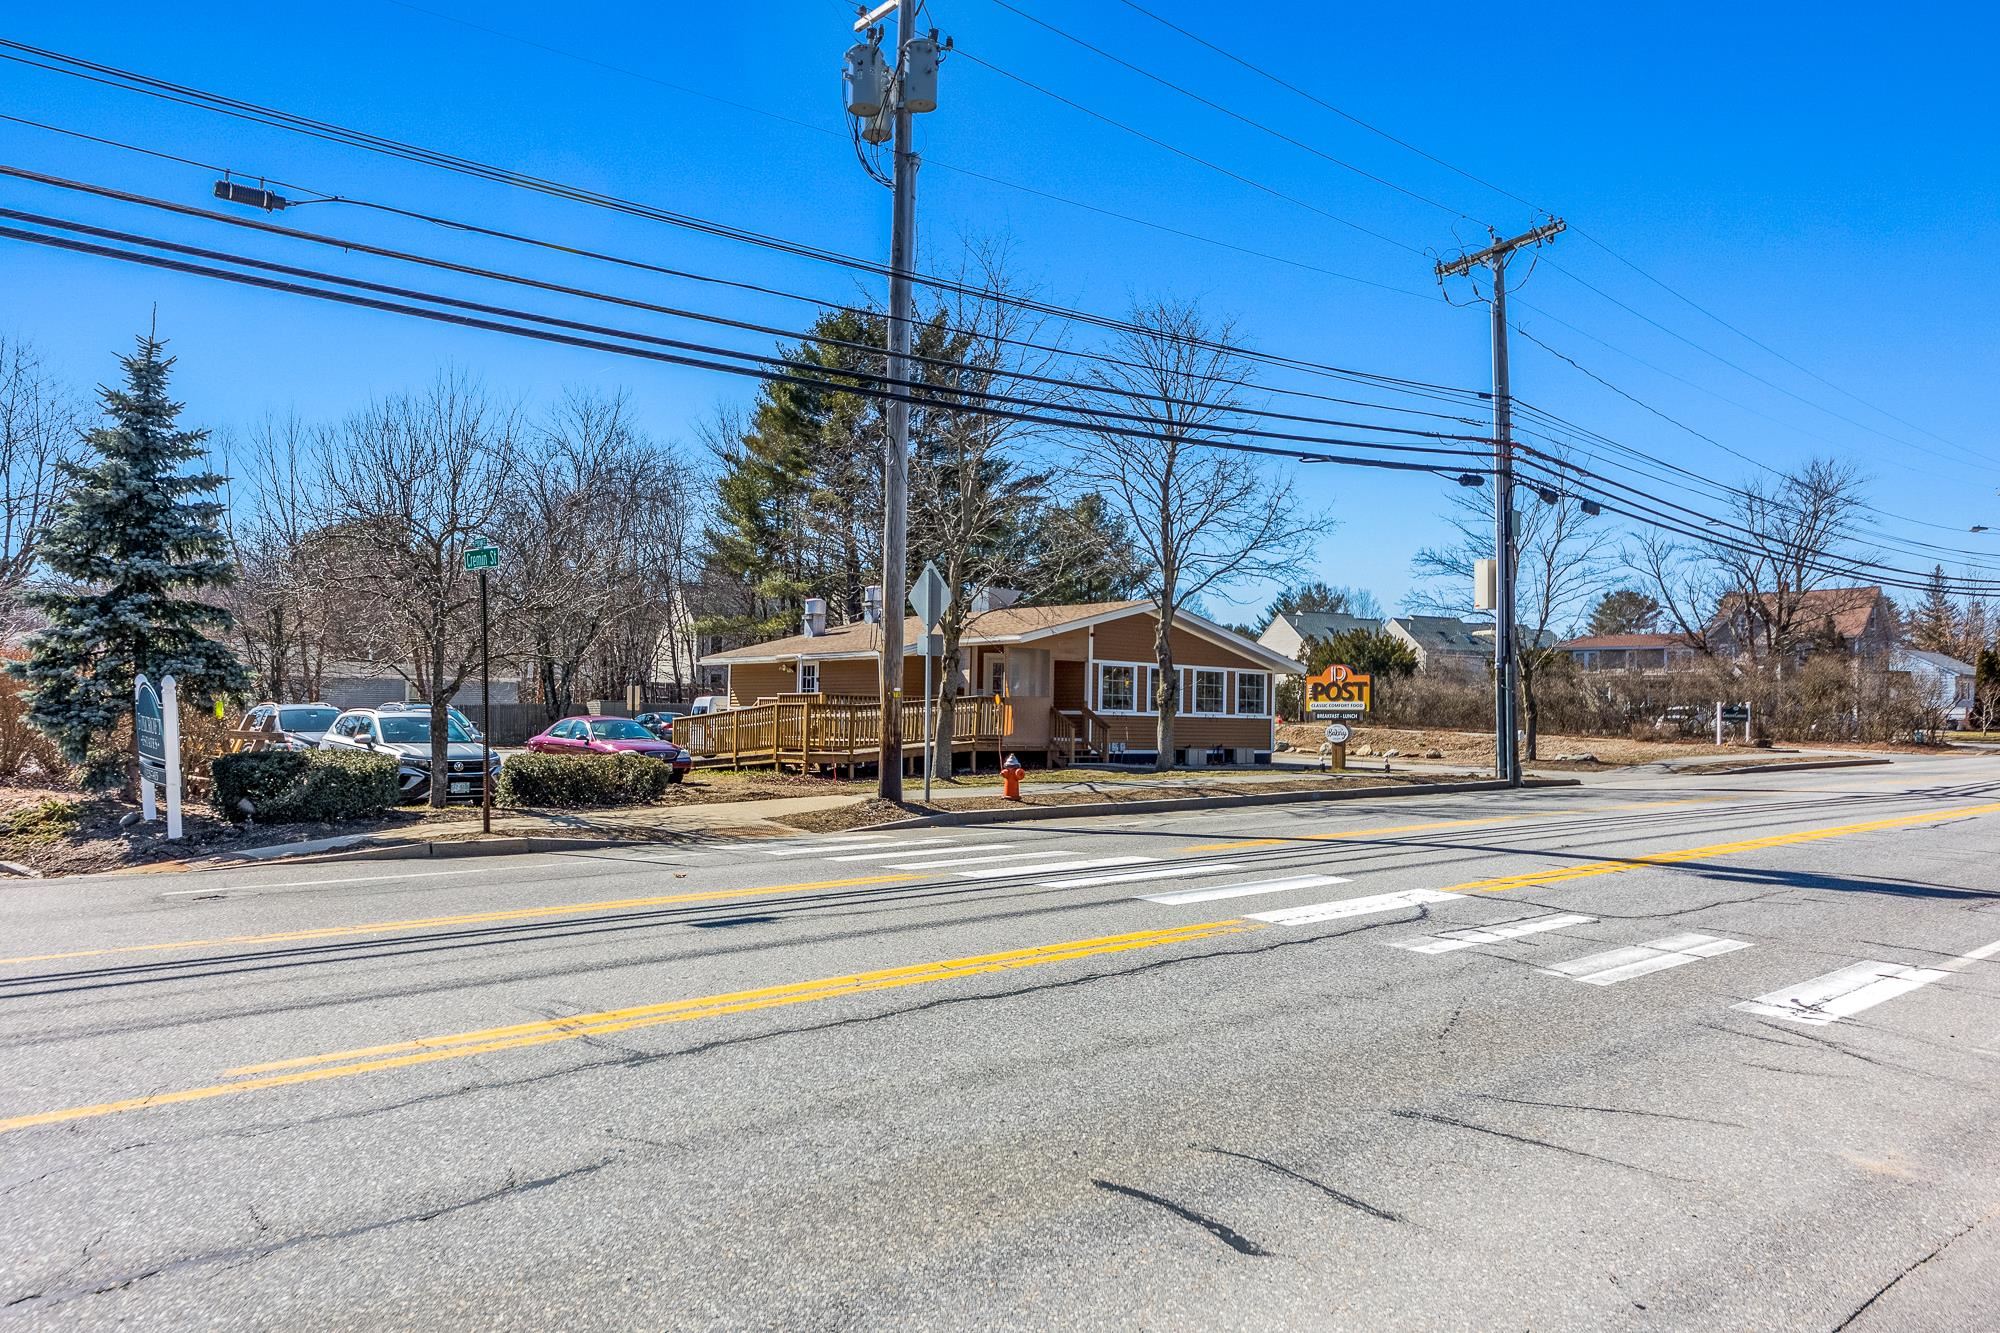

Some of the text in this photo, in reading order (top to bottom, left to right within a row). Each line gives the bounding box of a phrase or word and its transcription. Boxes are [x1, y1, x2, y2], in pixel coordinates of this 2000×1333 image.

[466, 550, 497, 568] Cremin St
[1311, 681, 1369, 702] POST
